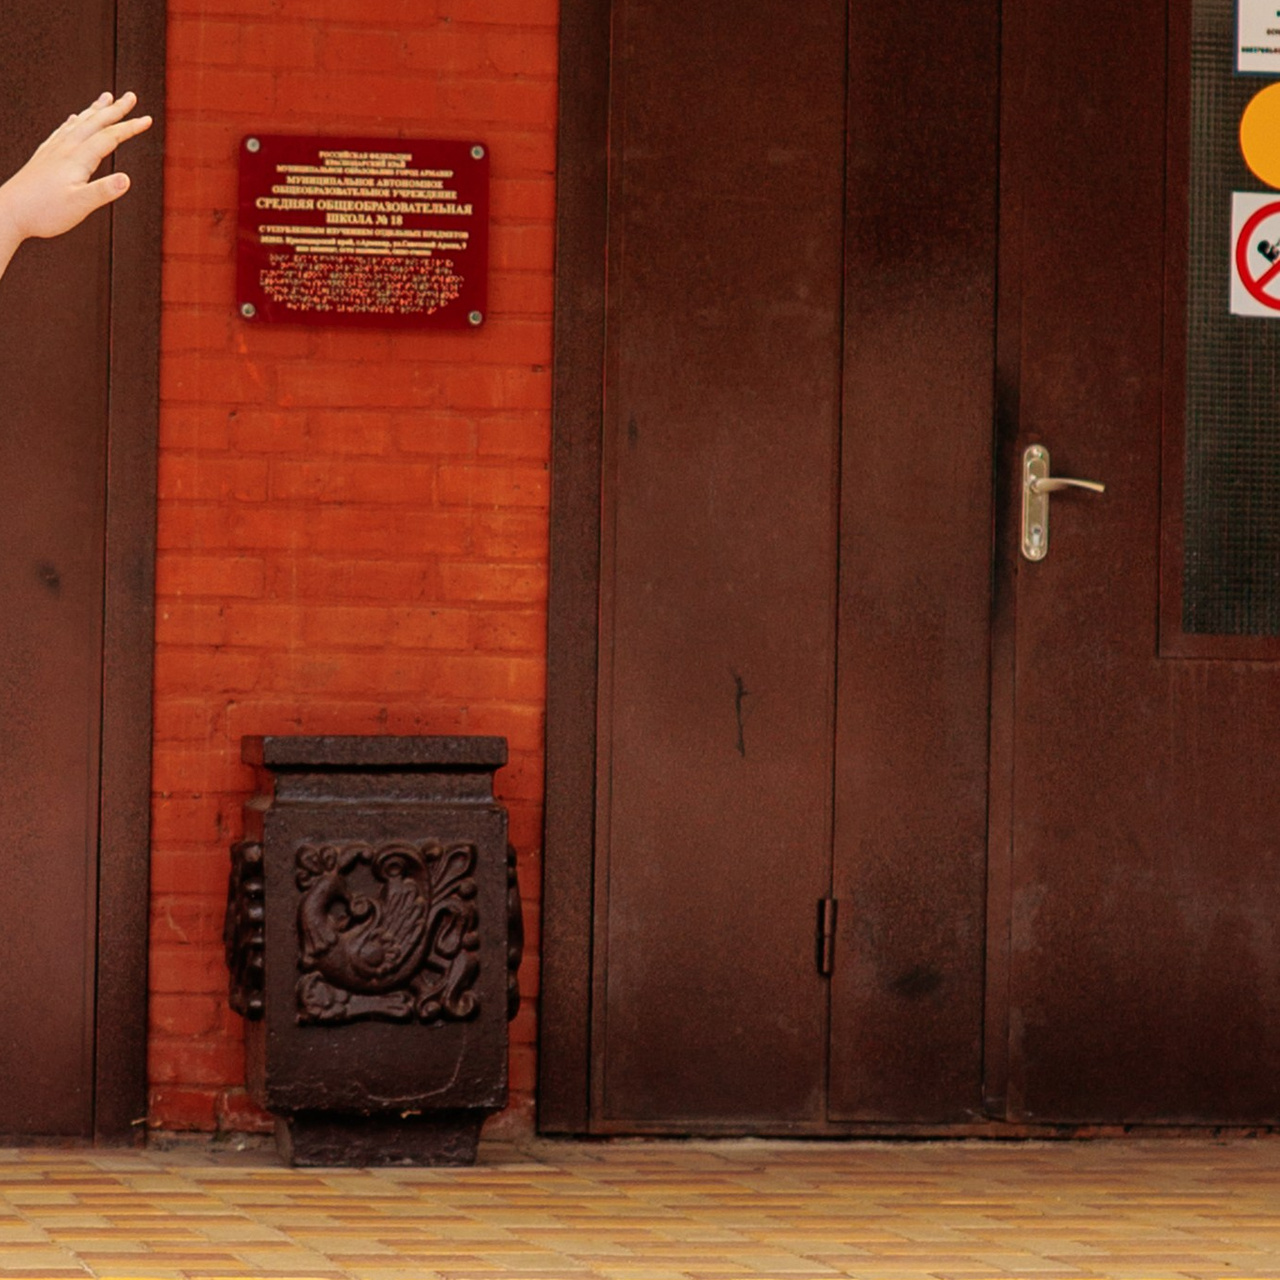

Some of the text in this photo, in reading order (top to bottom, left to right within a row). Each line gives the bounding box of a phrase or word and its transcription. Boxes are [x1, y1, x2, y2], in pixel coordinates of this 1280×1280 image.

[319, 150, 368, 160] РОССИЙСКАЯ
[286, 176, 444, 189] МУНИЦИПАЛЬНОЕ АВТОНОМНОЕ
[272, 186, 457, 200] ОБЩЕОБРАЗОВАТЕЛЬНОЕ УЧРЕЖДЕНИЕ
[256, 198, 473, 215] СРЕДНЯЯ ОБЩЕОБРАЗОВАТЕЛЬНАЯ
[326, 213, 404, 226] ШКОЛА № 18
